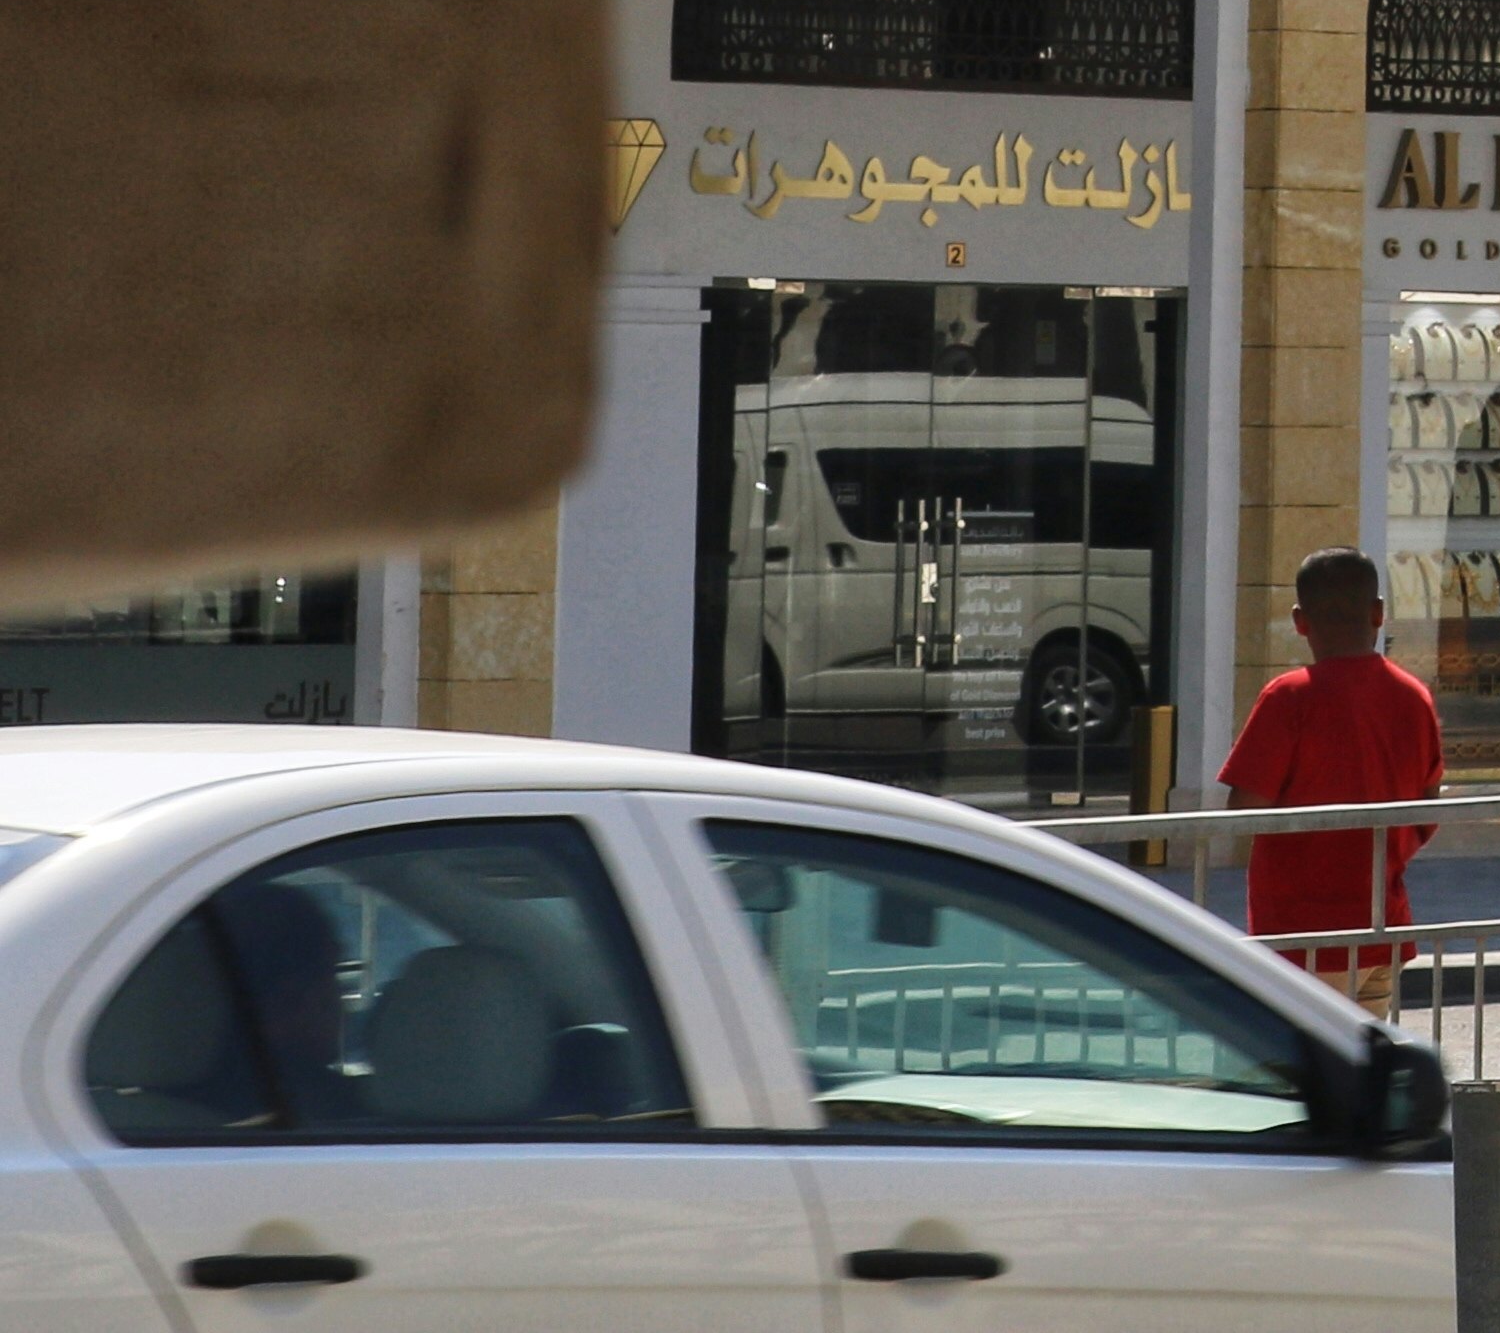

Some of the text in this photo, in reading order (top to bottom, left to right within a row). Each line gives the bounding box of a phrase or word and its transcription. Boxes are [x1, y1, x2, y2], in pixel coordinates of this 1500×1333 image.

[689, 126, 1192, 229] ازلت للمجوهرات
[1378, 129, 1481, 210] AL
[950, 246, 962, 264] 2
